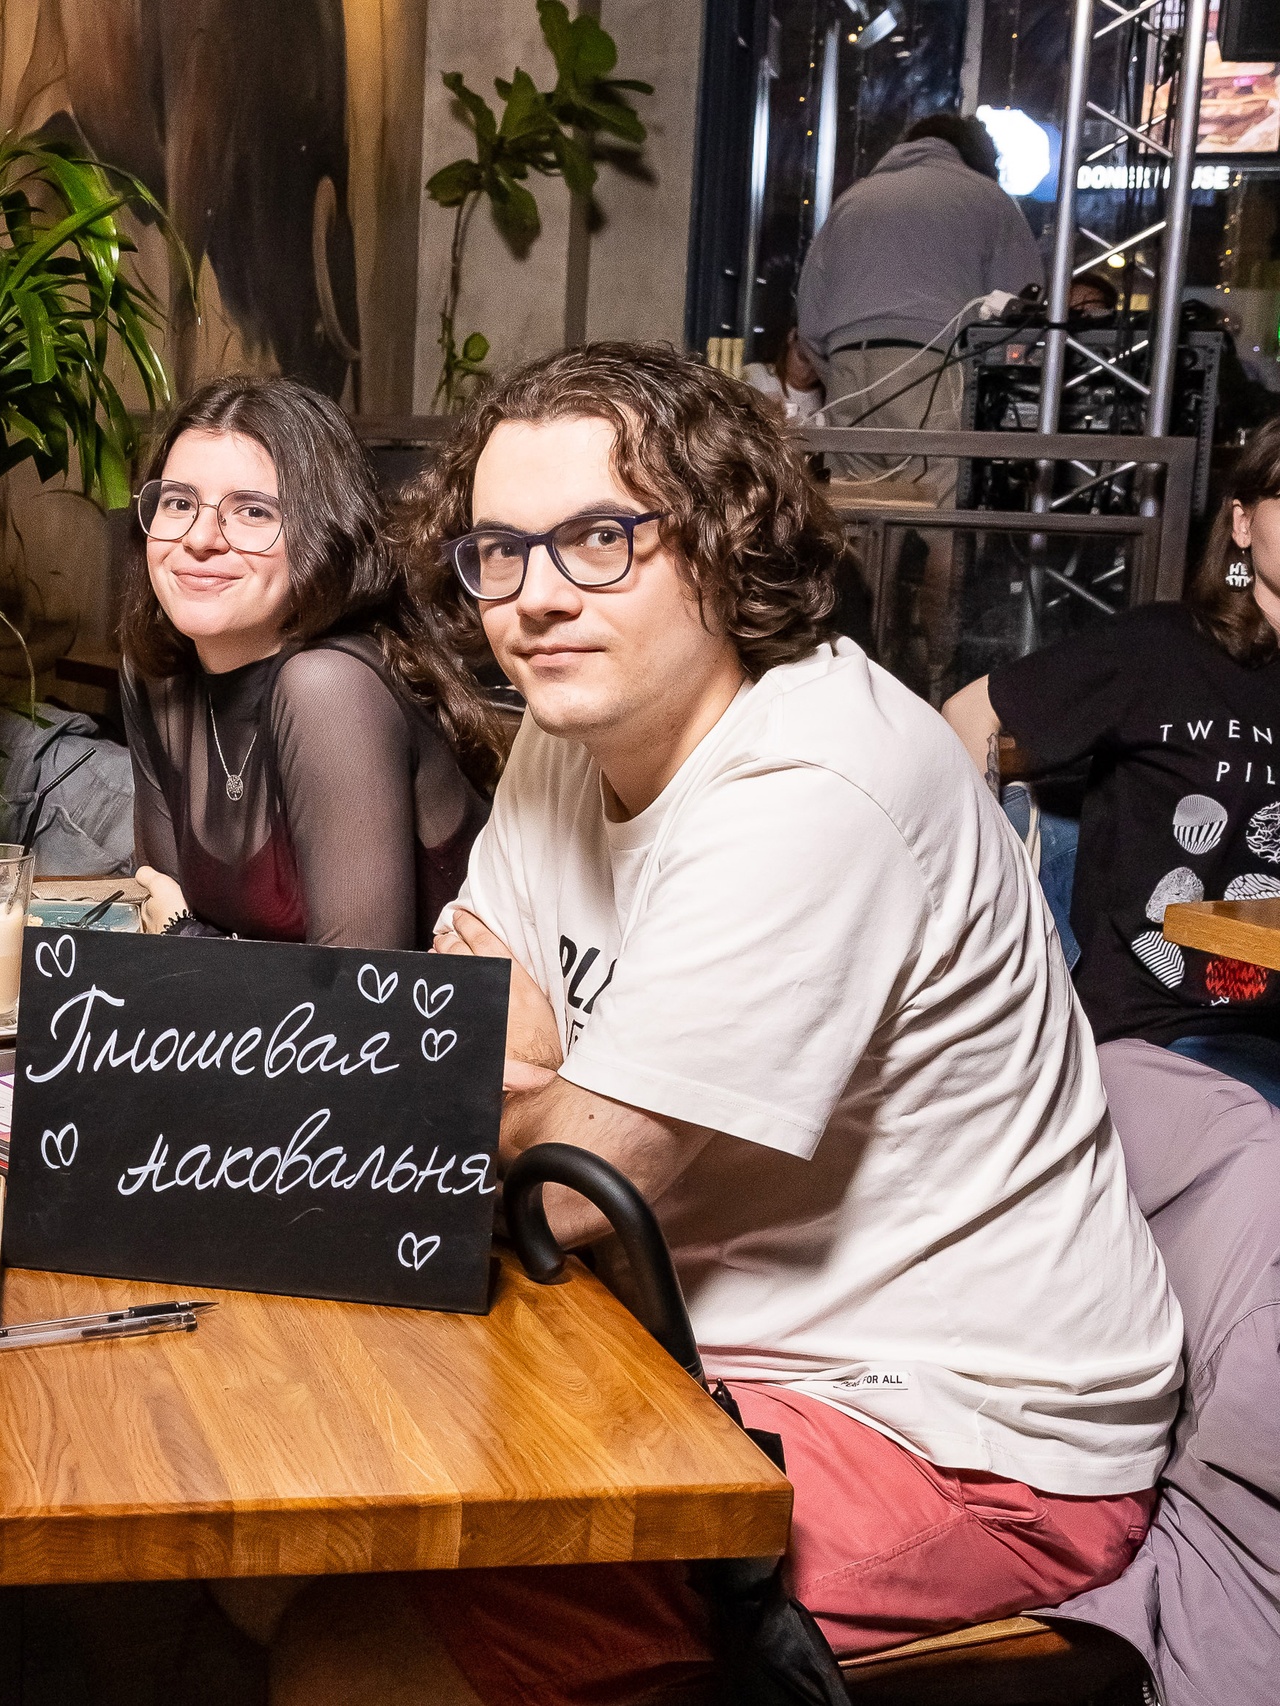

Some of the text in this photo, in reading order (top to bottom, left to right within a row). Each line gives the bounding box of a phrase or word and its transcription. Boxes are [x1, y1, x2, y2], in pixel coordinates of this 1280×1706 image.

[1160, 719, 1274, 745] TWEN
[25, 984, 401, 1083] Плюшевая
[882, 1374, 903, 1384] ALL
